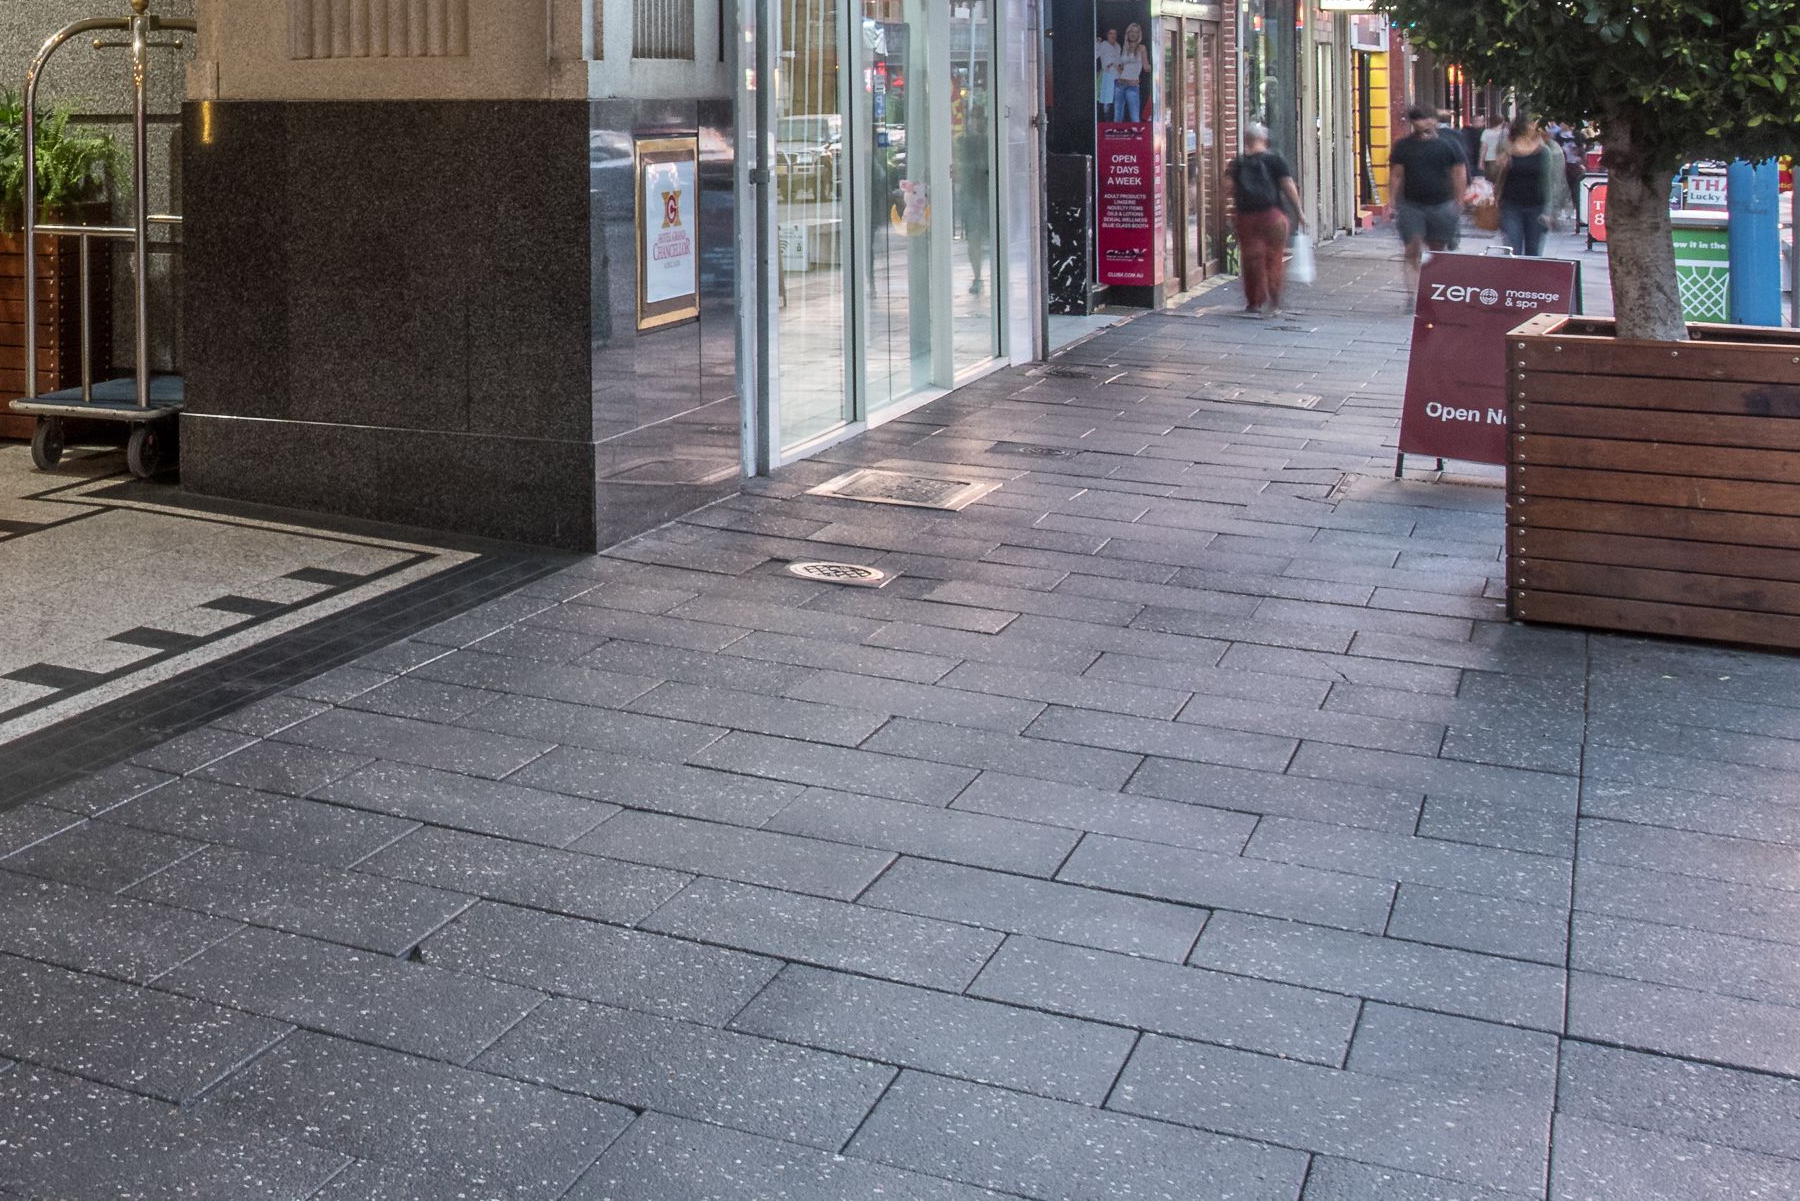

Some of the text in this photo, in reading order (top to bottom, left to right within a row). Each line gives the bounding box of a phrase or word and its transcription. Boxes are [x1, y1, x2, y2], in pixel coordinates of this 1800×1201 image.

[1111, 154, 1137, 163] OPEN
[1110, 166, 1140, 174] 7 DAYS
[1107, 177, 1142, 185] A WEEK
[1690, 192, 1721, 203] Lucky
[1710, 241, 1727, 250] the
[1505, 289, 1560, 304] massage
[1504, 297, 1538, 310] & spa
[1426, 401, 1481, 424] Open
